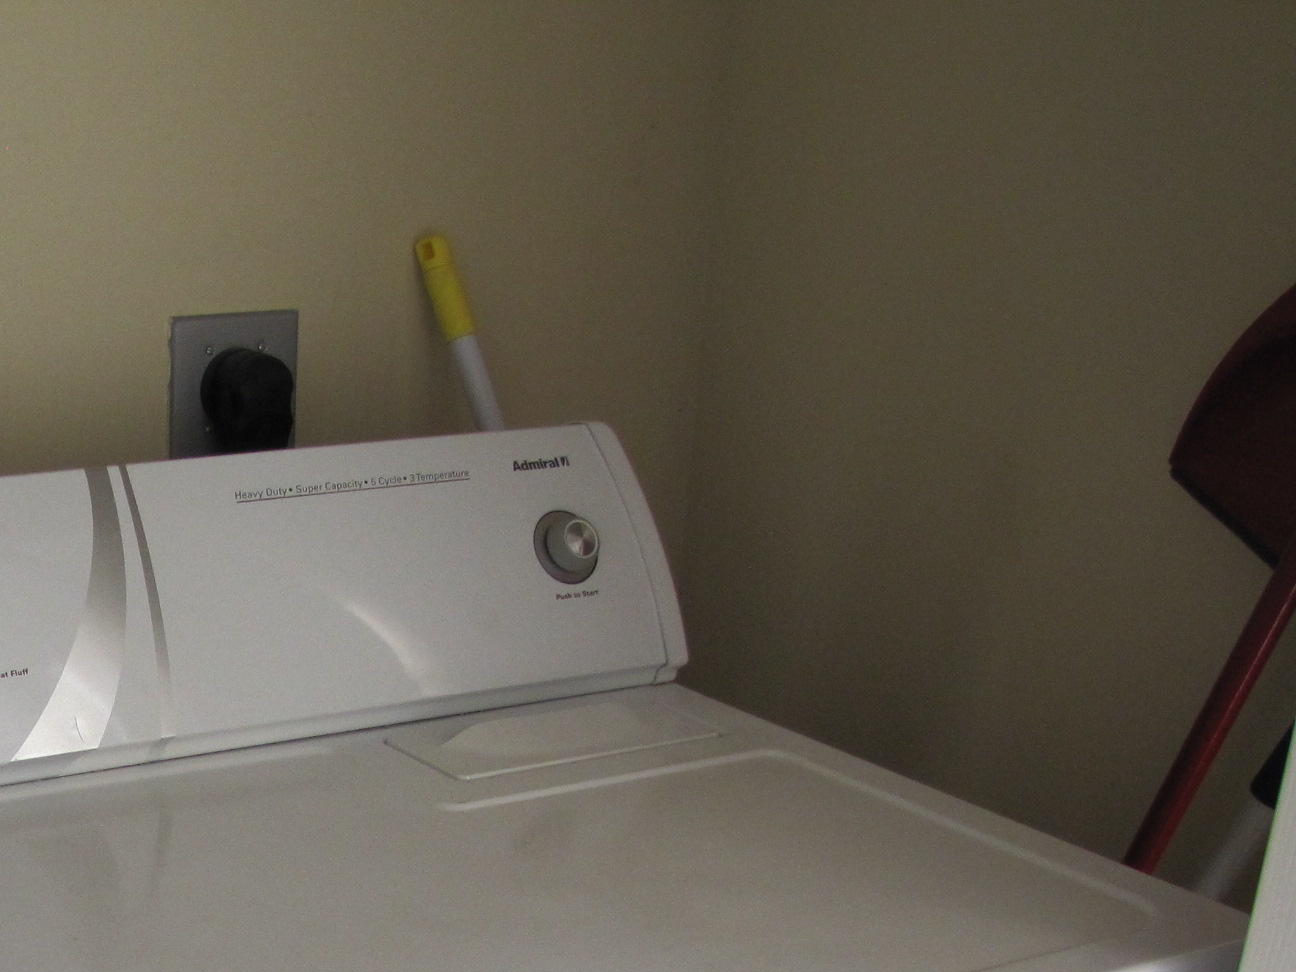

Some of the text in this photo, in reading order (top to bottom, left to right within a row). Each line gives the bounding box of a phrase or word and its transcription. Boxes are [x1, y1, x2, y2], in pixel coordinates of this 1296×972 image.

[513, 457, 561, 471] Admiral
[234, 489, 263, 500] Heavy
[266, 487, 288, 498] Duty
[295, 484, 323, 495] Super
[324, 479, 363, 491] Capacity
[378, 475, 402, 487] Cycle
[416, 469, 469, 482] Temperature
[10, 667, 29, 677] Fluff
